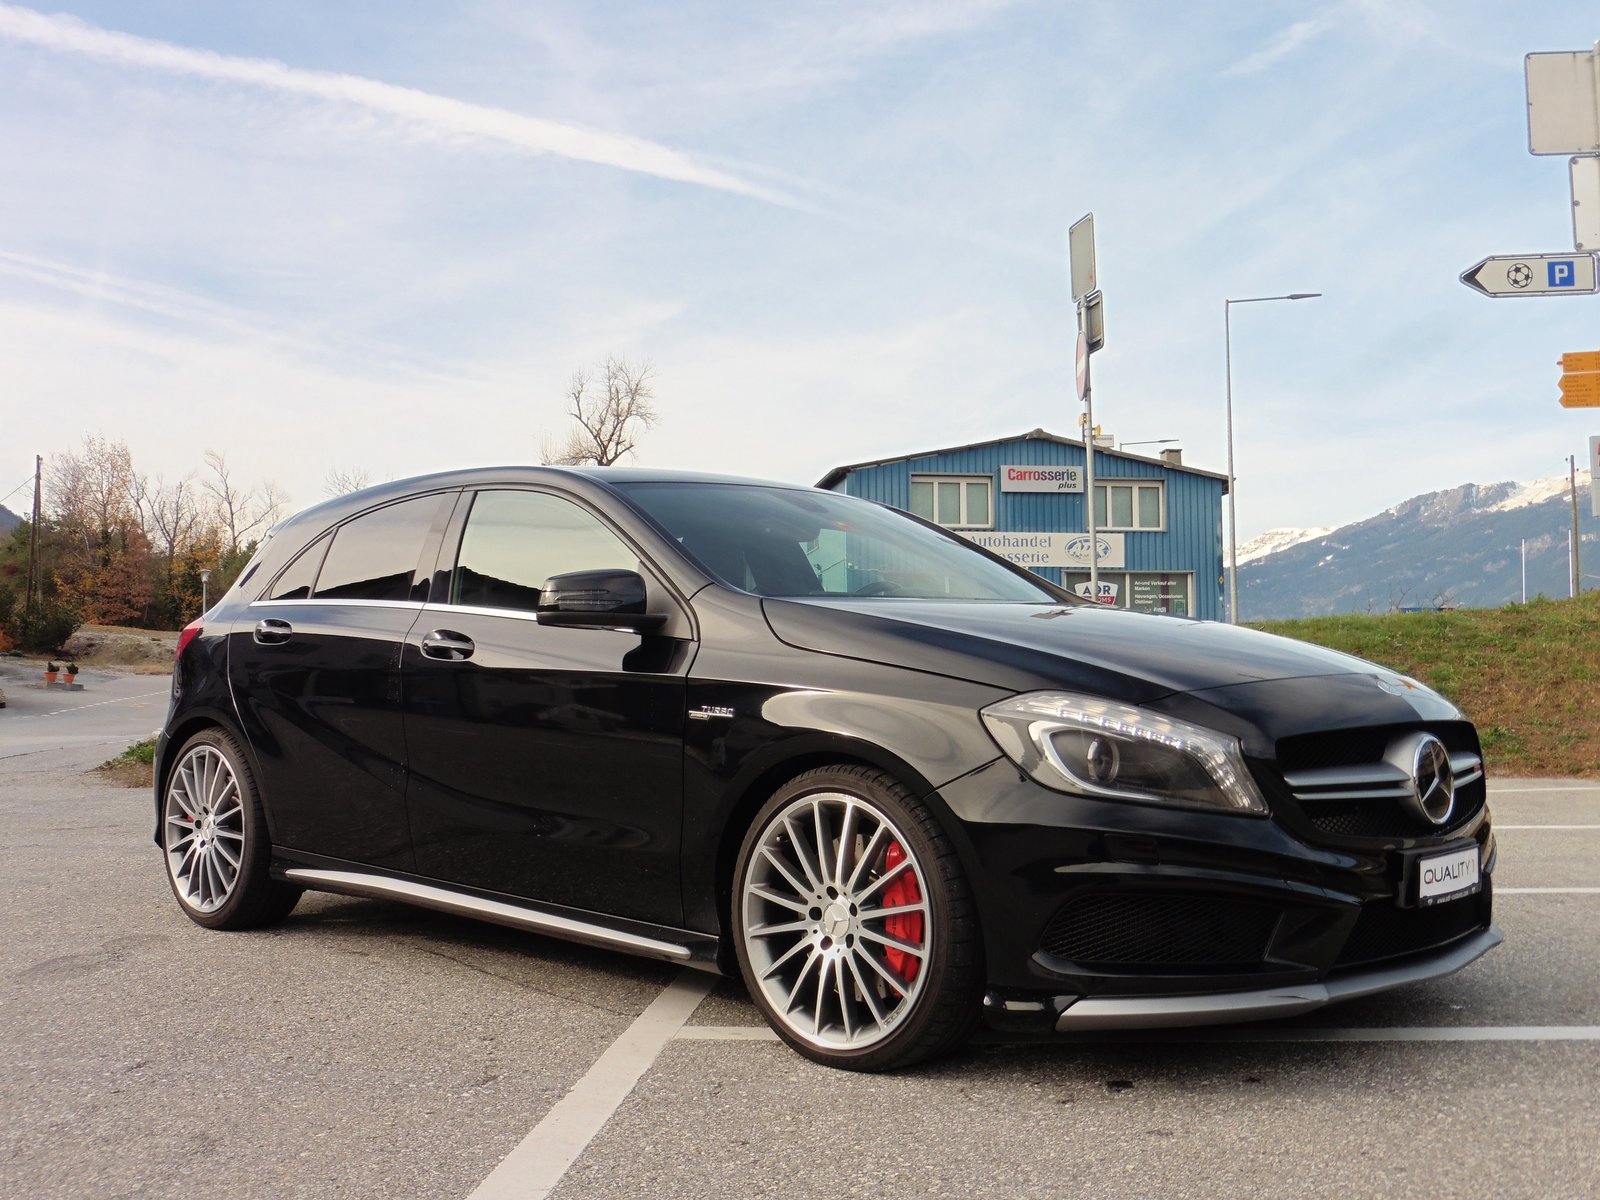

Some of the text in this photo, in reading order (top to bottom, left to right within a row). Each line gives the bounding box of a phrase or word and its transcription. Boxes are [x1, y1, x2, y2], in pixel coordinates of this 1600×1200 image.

[1554, 265, 1568, 284] P
[1007, 467, 1077, 481] Carrosserie
[1057, 481, 1077, 490] plus
